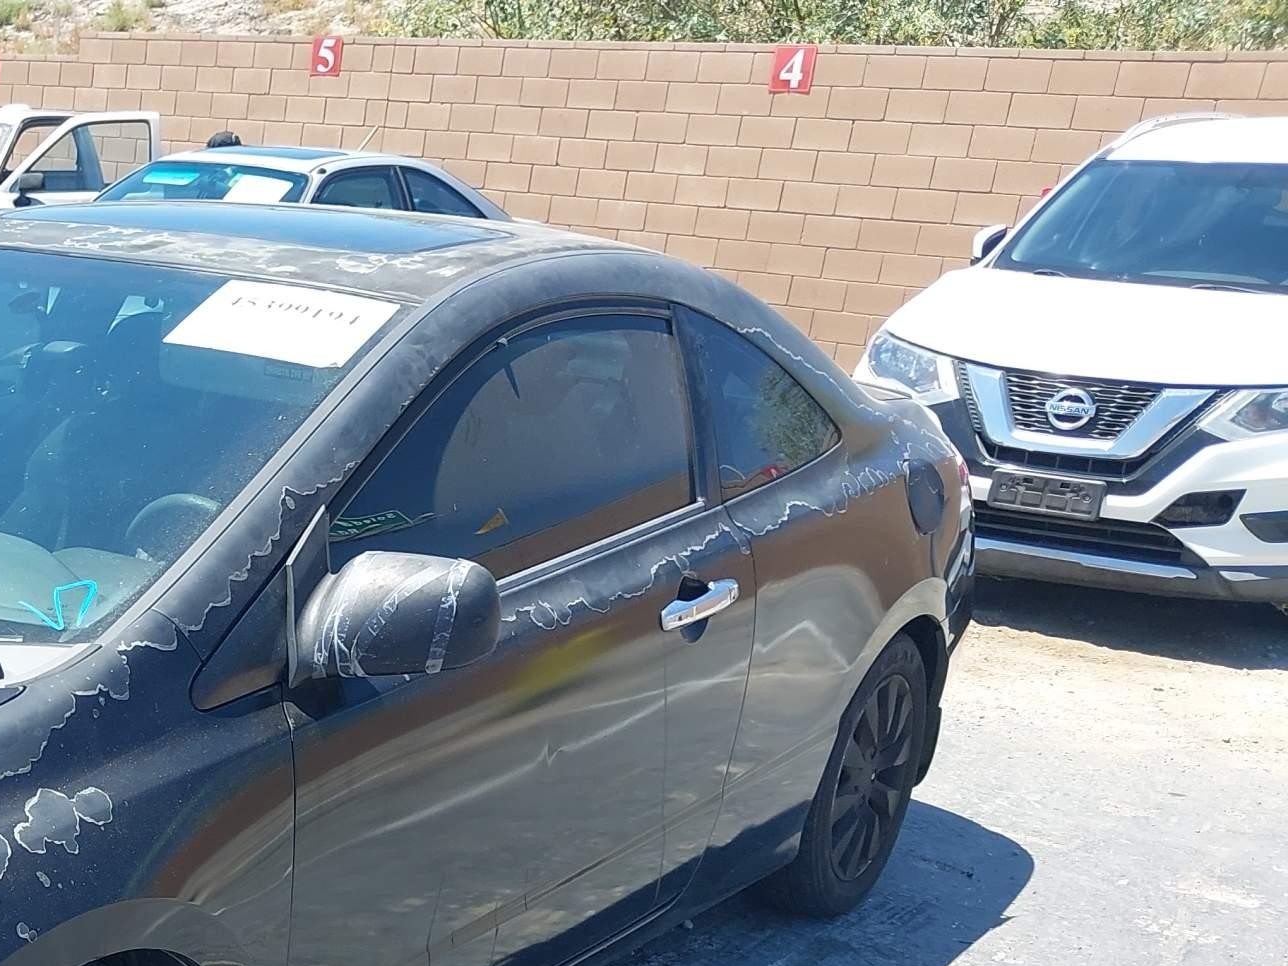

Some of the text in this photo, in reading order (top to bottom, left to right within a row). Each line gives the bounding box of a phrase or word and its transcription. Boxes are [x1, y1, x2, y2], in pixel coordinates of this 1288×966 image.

[316, 38, 337, 73] 5
[778, 48, 805, 89] 4
[1049, 403, 1090, 415] NISSAN
